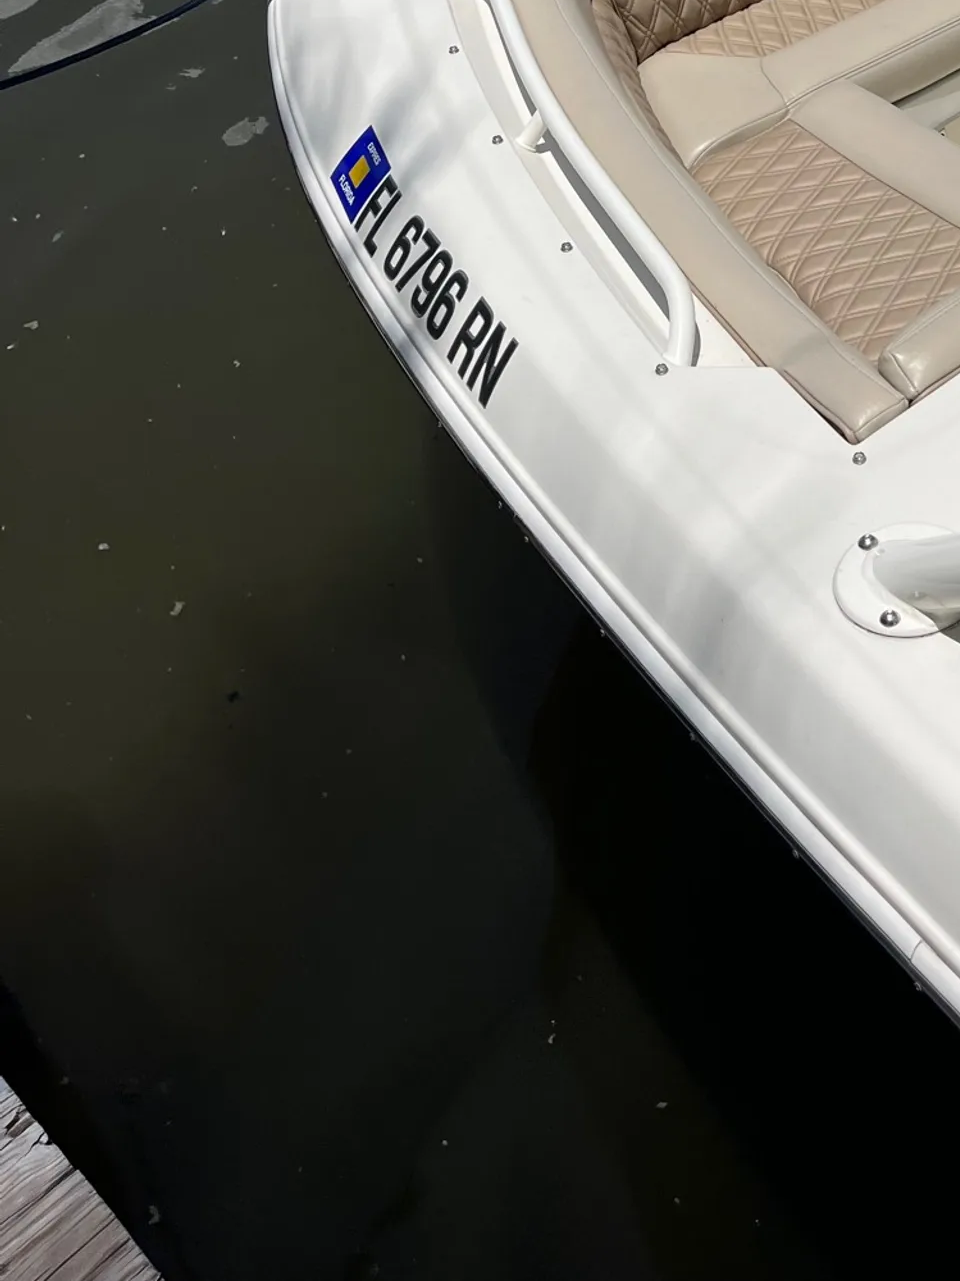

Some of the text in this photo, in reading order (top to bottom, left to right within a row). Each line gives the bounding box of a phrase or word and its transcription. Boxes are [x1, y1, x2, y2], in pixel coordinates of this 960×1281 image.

[339, 173, 355, 206] FLORIDA
[355, 174, 519, 409] FL 6796 RN
